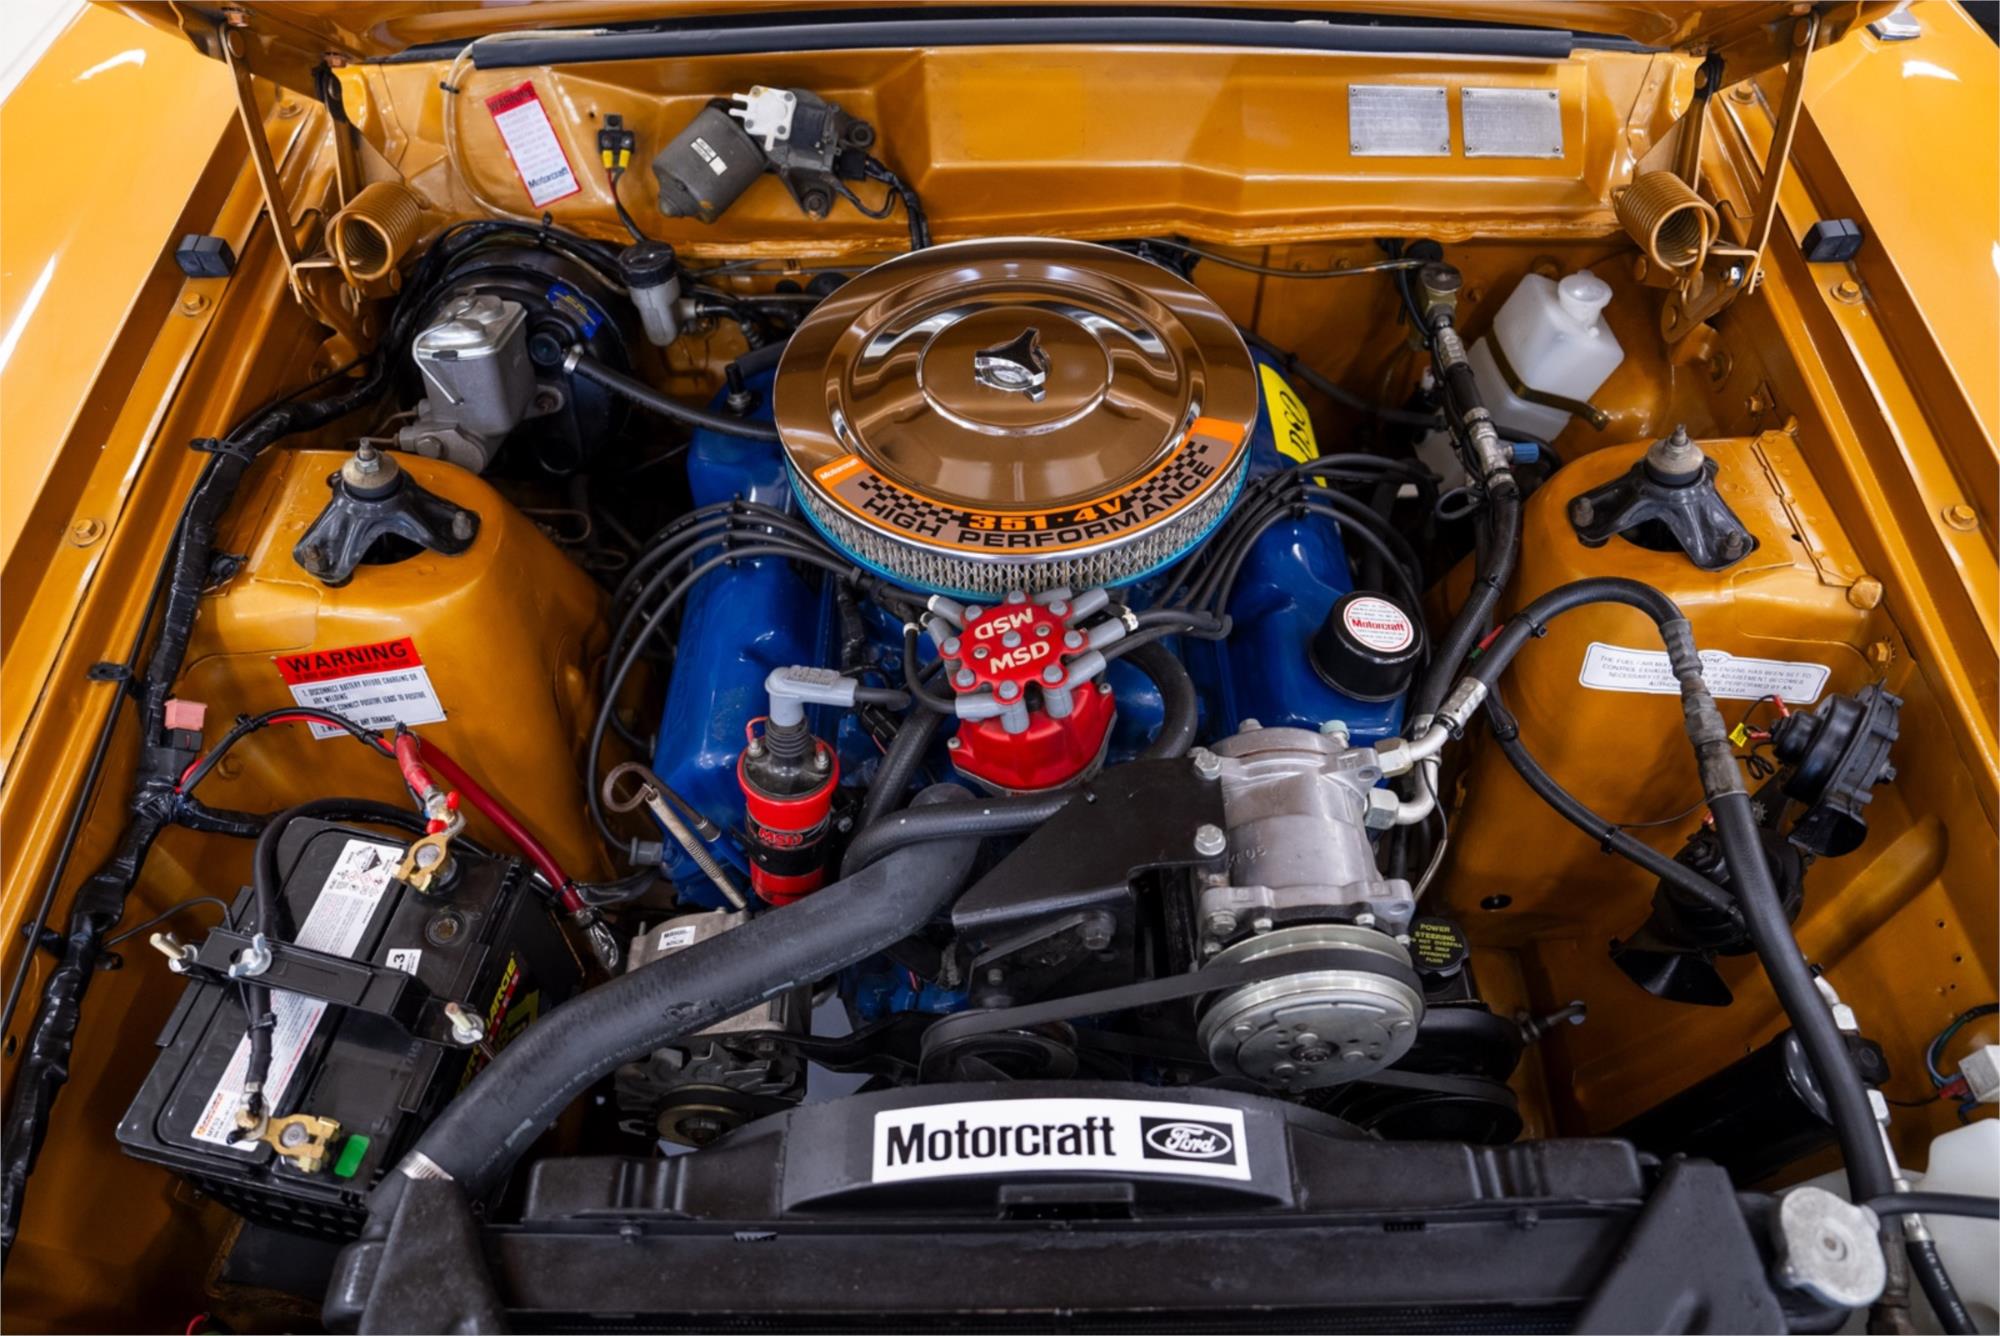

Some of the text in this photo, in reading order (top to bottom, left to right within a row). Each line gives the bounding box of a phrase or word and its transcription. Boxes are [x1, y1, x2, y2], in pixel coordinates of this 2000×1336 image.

[527, 166, 570, 189] Motorcraft
[819, 458, 859, 480] Motorcraft
[861, 462, 1216, 548] HIGH PERFORMANCE
[974, 607, 1034, 640] MSD
[1351, 618, 1405, 632] Motorcraft
[286, 642, 407, 674] WARNING
[989, 640, 1050, 675] MSD
[758, 826, 804, 847] MSD
[1414, 931, 1456, 942] STEERING
[1420, 923, 1451, 933] POWER
[886, 1116, 1217, 1167] Motorcraft Ford
